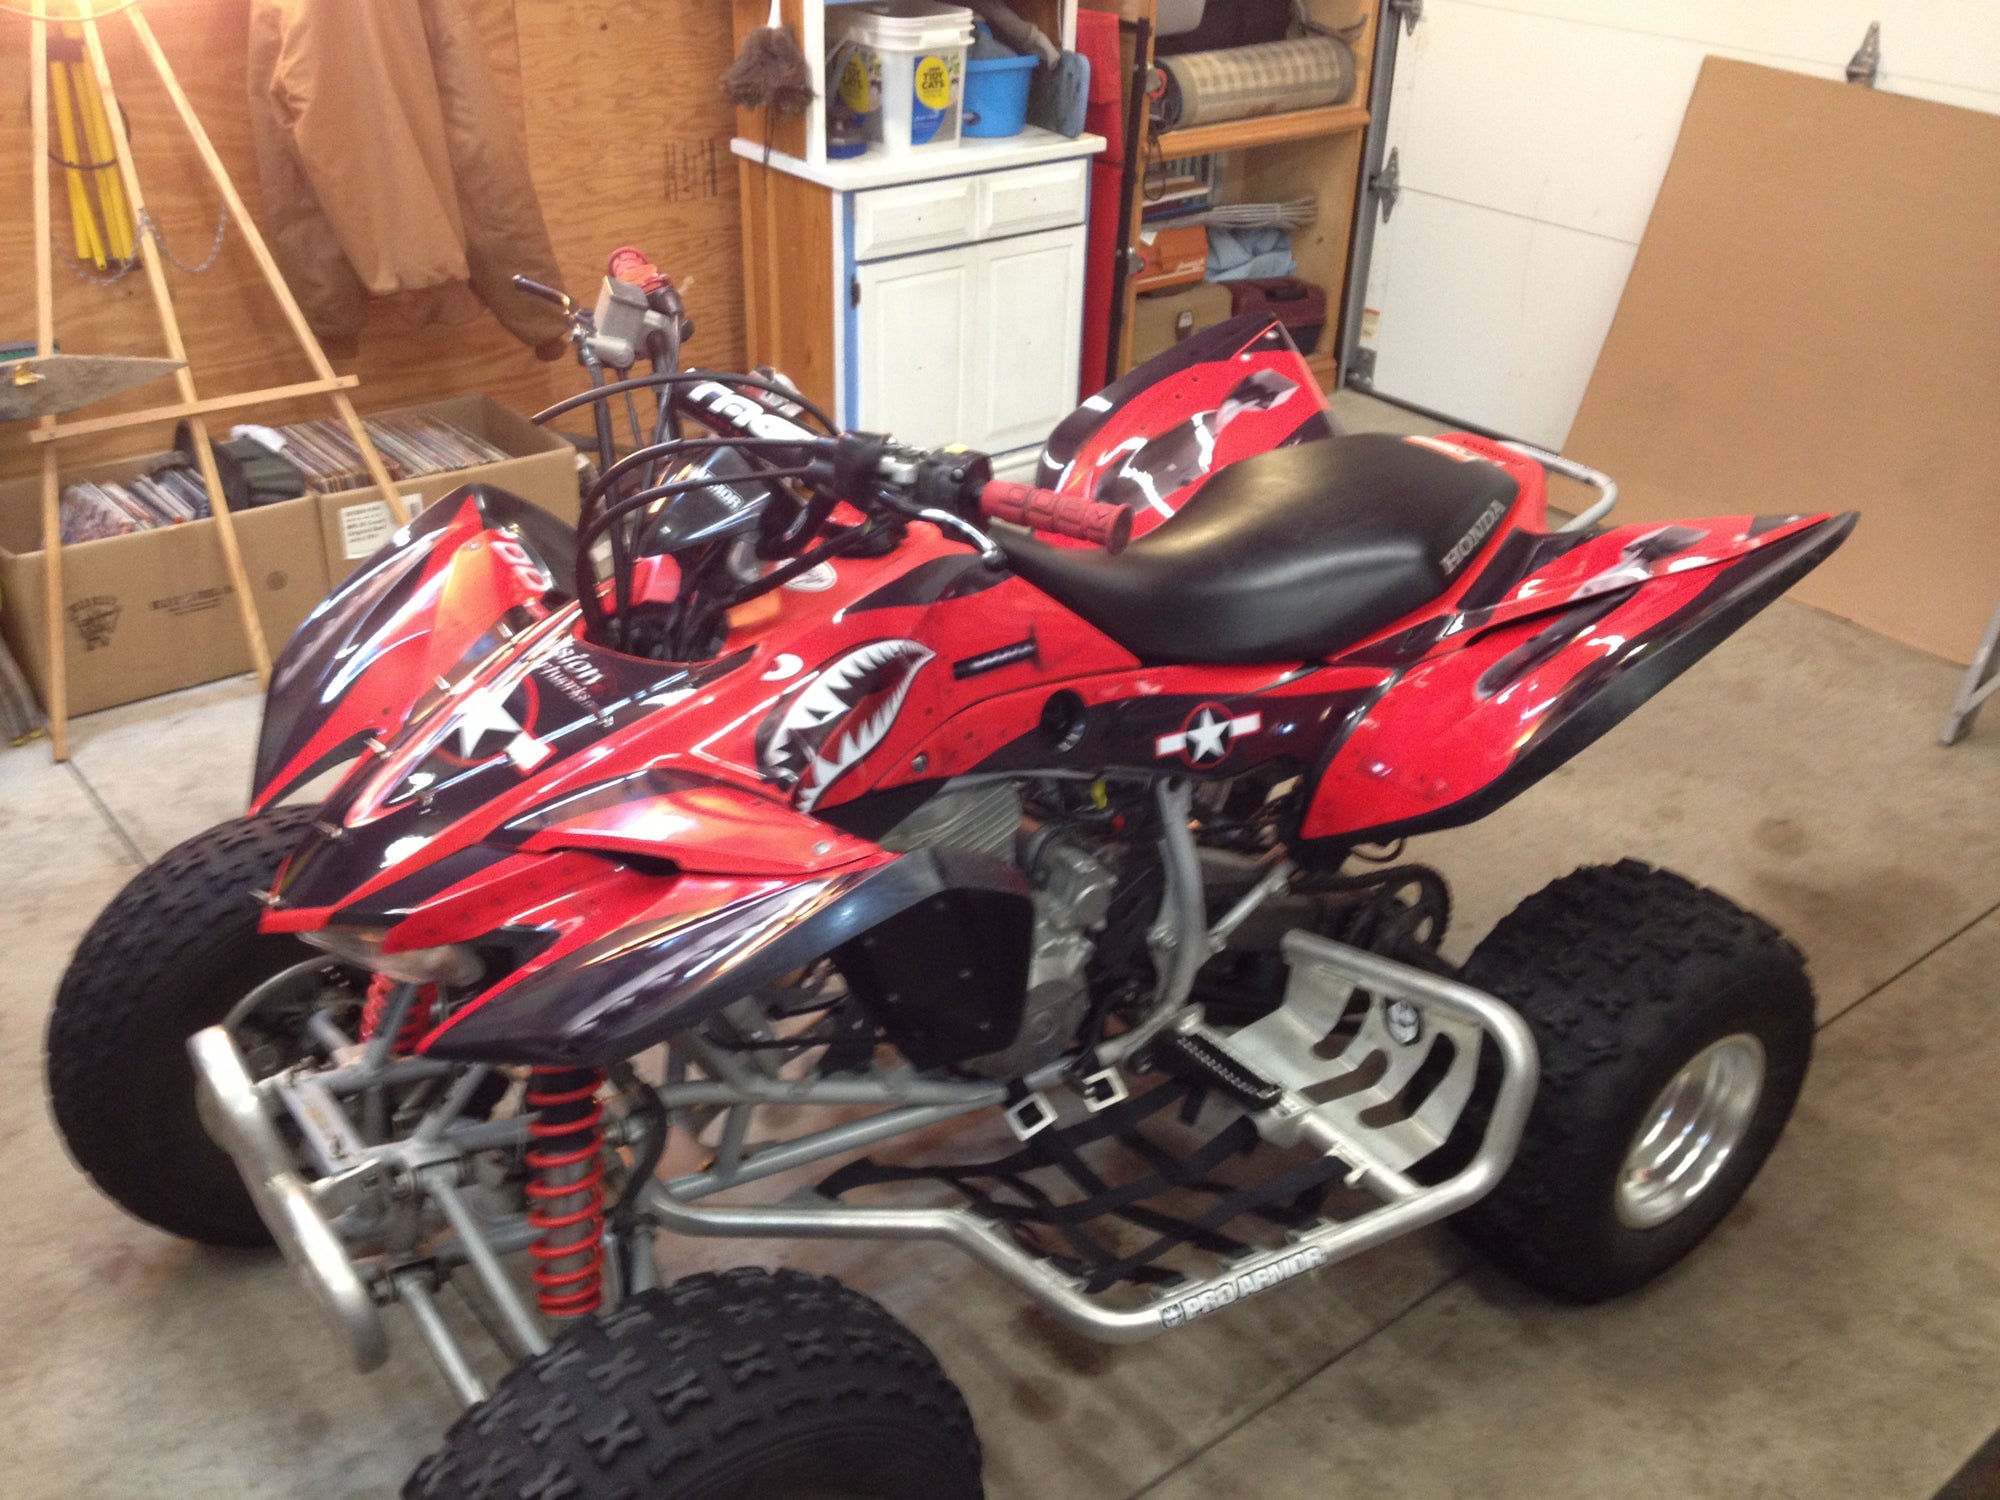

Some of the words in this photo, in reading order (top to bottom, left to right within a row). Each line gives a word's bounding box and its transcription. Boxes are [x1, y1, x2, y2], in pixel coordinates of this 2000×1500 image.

[921, 80, 945, 90] CATS
[922, 71, 944, 81] TIDY
[1440, 500, 1506, 575] HONDA
[1181, 1283, 1238, 1320] PRO
[1237, 1246, 1328, 1298] ARMOR
